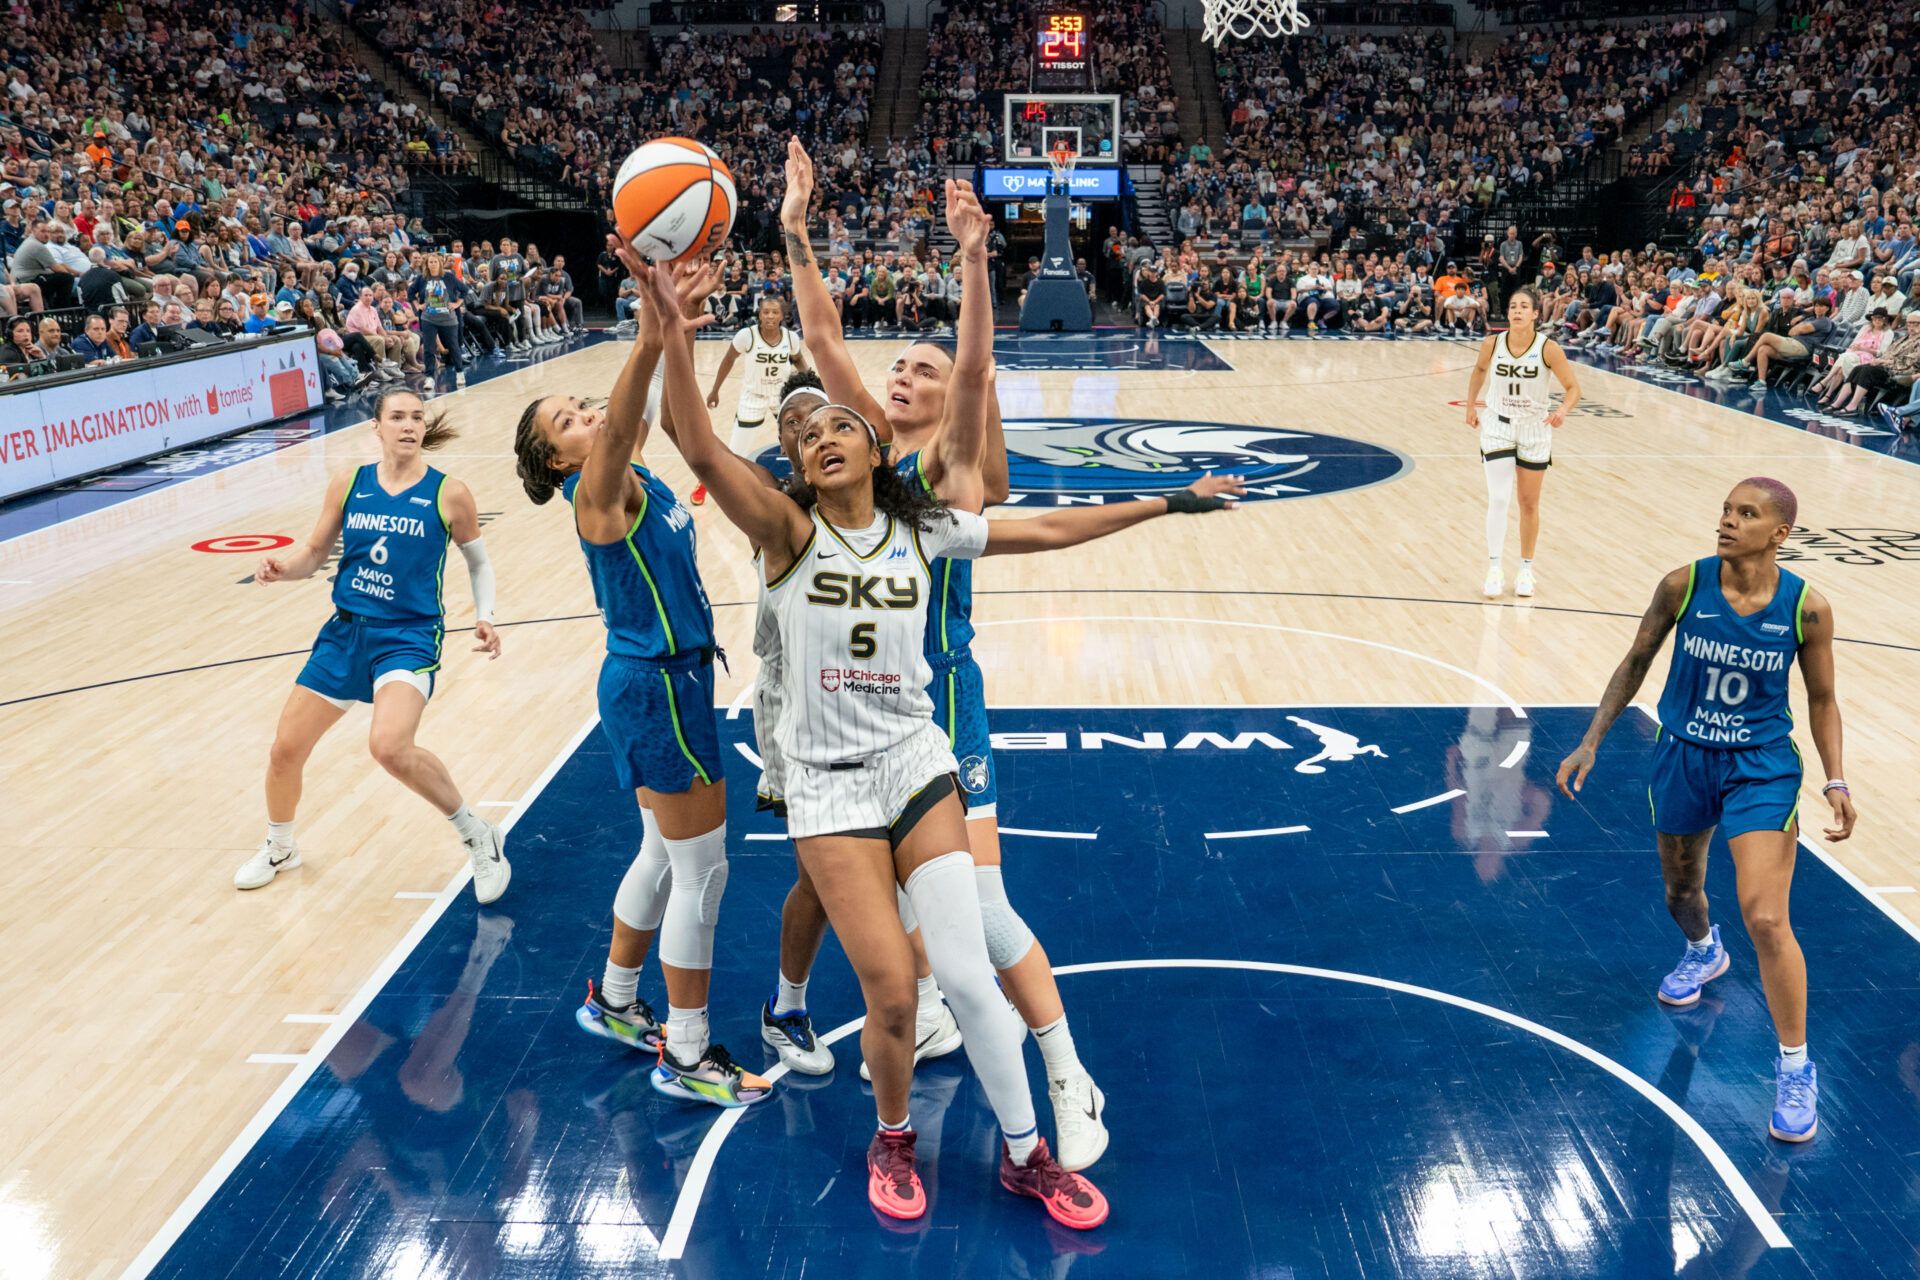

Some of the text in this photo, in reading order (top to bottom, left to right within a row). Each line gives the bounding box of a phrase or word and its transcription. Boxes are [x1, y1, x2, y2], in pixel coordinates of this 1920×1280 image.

[1050, 16, 1083, 31] 5:53
[1044, 31, 1080, 57] 24
[1062, 177, 1099, 188] LINIC
[1043, 268, 1070, 276] Fanatics
[755, 352, 788, 364] SKY
[765, 366, 779, 377] 12
[1495, 364, 1539, 379] SKY
[1508, 382, 1520, 396] 11
[42, 398, 170, 453] IMAGINATION
[174, 393, 203, 420] with
[346, 512, 425, 538] MINNESOTA
[369, 536, 388, 565] 6
[357, 566, 393, 586] MAYO
[351, 578, 395, 600] CLINIC
[805, 571, 919, 610] SKY
[849, 621, 877, 660] 5
[1684, 631, 1784, 672] MINNESOTA
[843, 669, 901, 683] UChicago
[1705, 666, 1749, 706] 10
[843, 681, 901, 695] Medicine
[1694, 705, 1745, 727] MAYO
[989, 731, 1294, 749] WNB
[1686, 721, 1751, 743] CLINIC
